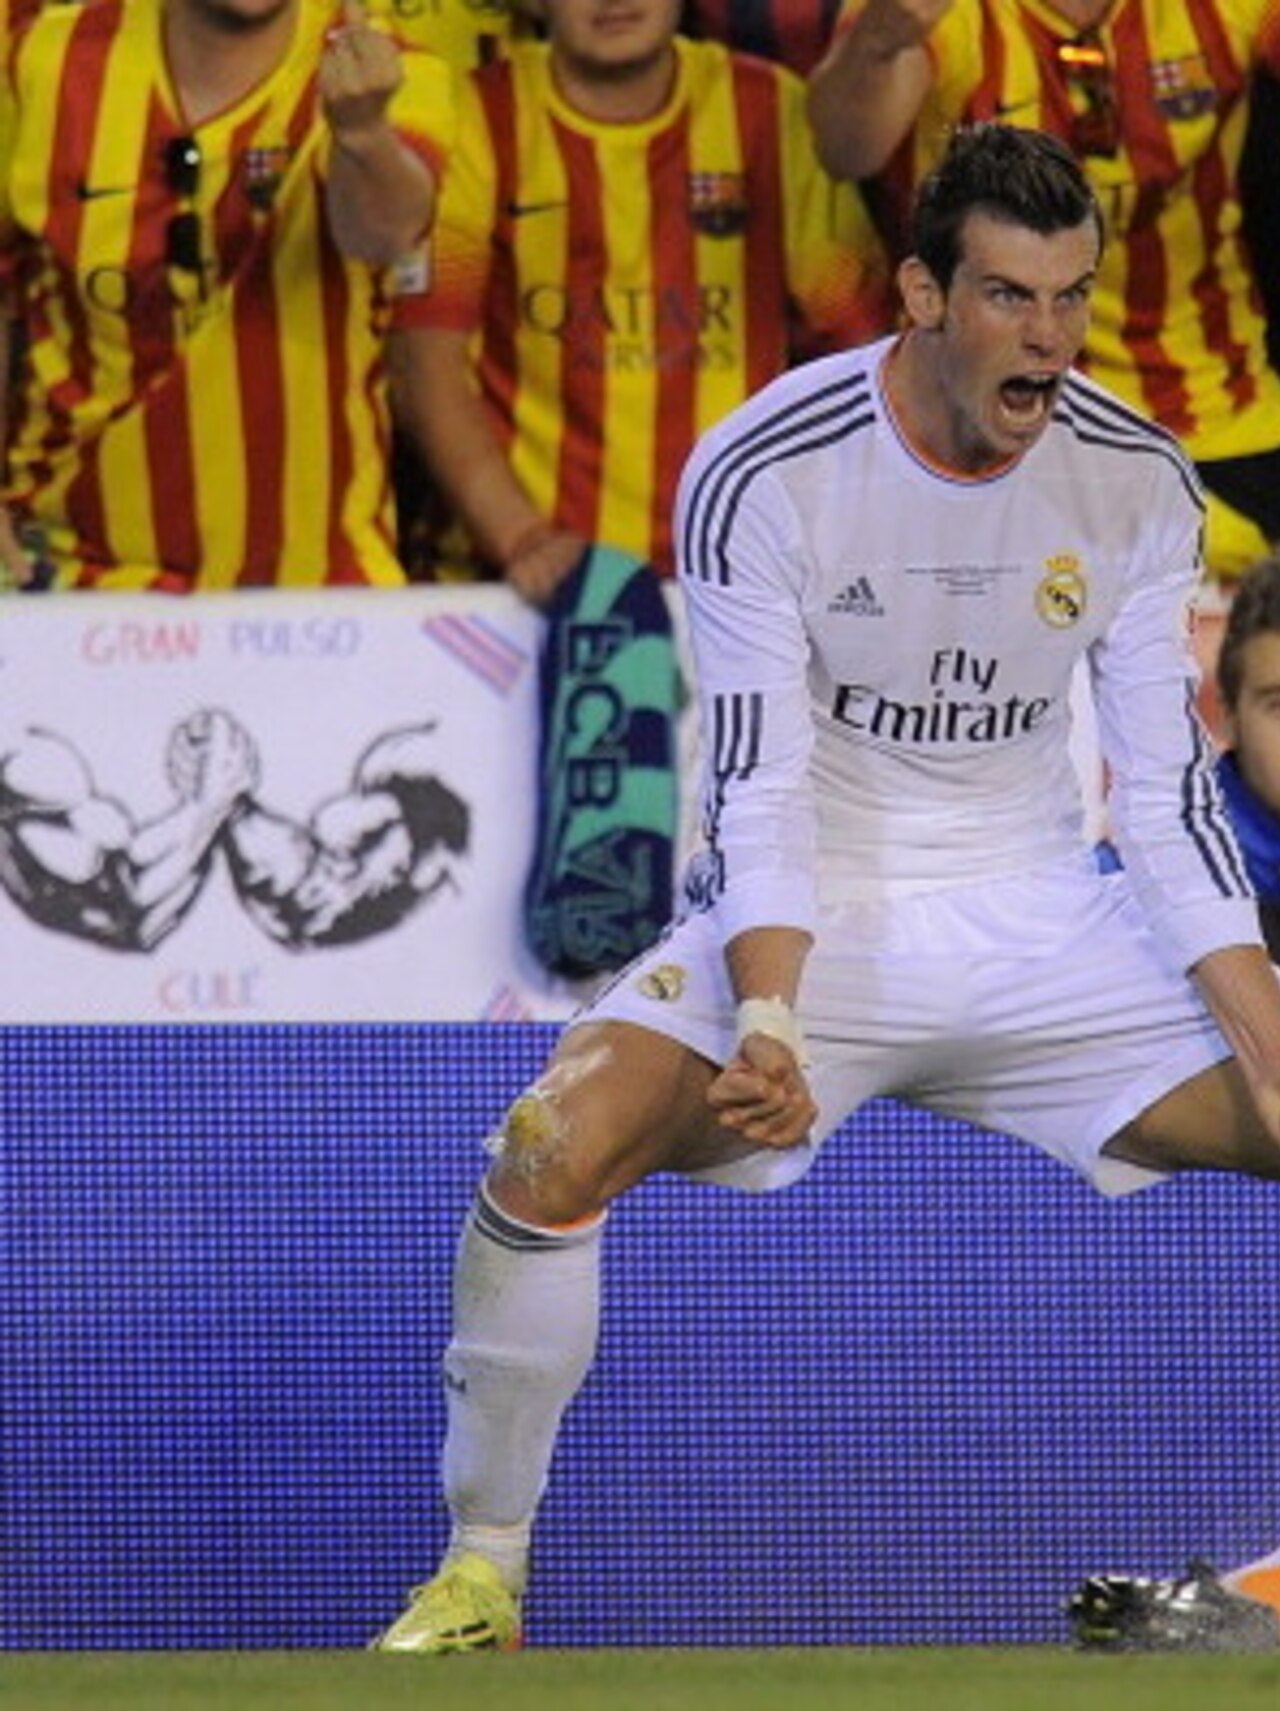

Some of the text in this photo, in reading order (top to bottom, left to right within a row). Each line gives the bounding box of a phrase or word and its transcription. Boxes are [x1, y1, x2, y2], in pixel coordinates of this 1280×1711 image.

[80, 618, 201, 666] GRAN
[929, 648, 998, 694] Fly
[832, 684, 1057, 742] Emirate
